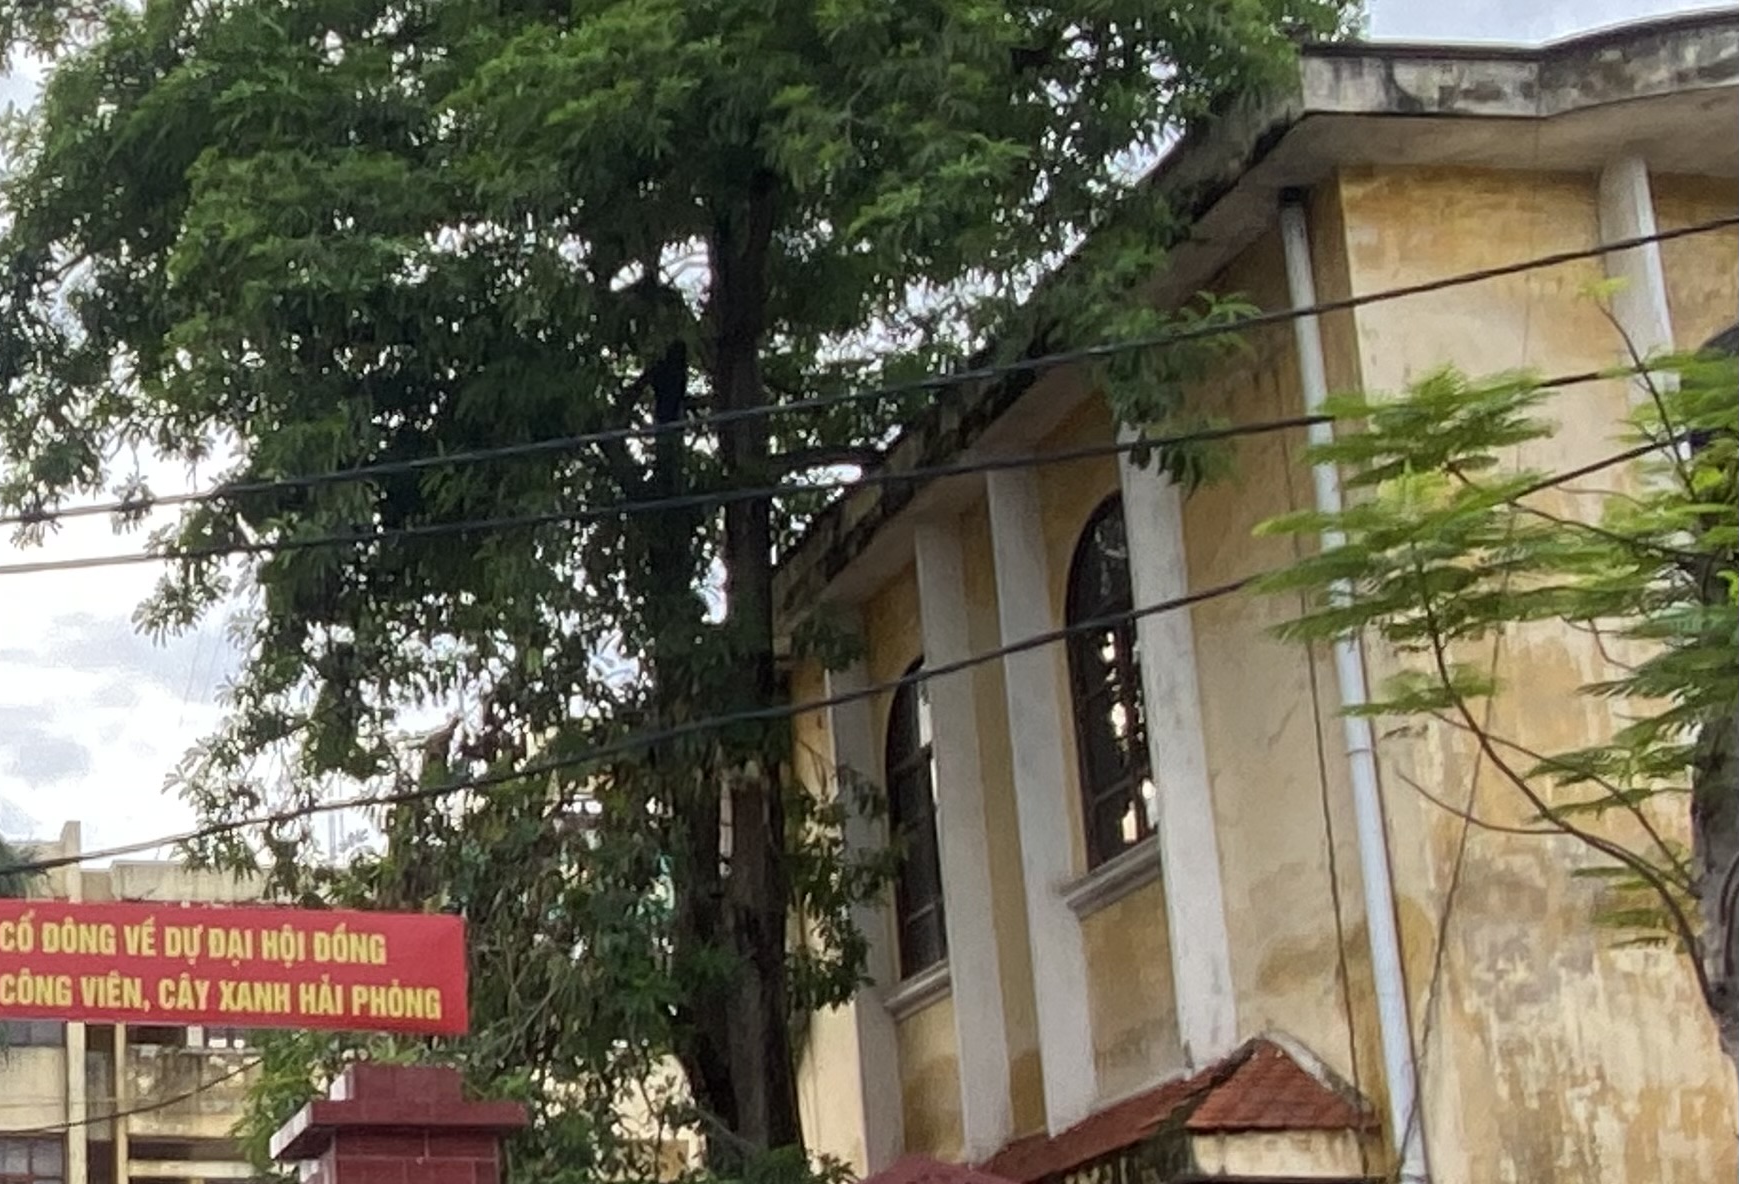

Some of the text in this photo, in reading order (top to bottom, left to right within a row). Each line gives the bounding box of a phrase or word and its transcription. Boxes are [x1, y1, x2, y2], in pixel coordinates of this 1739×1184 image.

[42, 916, 116, 955] ĐÔNG
[164, 925, 203, 964] DỰ
[207, 928, 253, 966] ĐẠI
[261, 924, 306, 968] HỘI
[80, 970, 150, 1011] VIÊN,
[158, 972, 210, 1010] CÂY
[218, 979, 291, 1013] XANH
[299, 974, 343, 1015] HẢI
[351, 979, 441, 1019] PHÒNG
